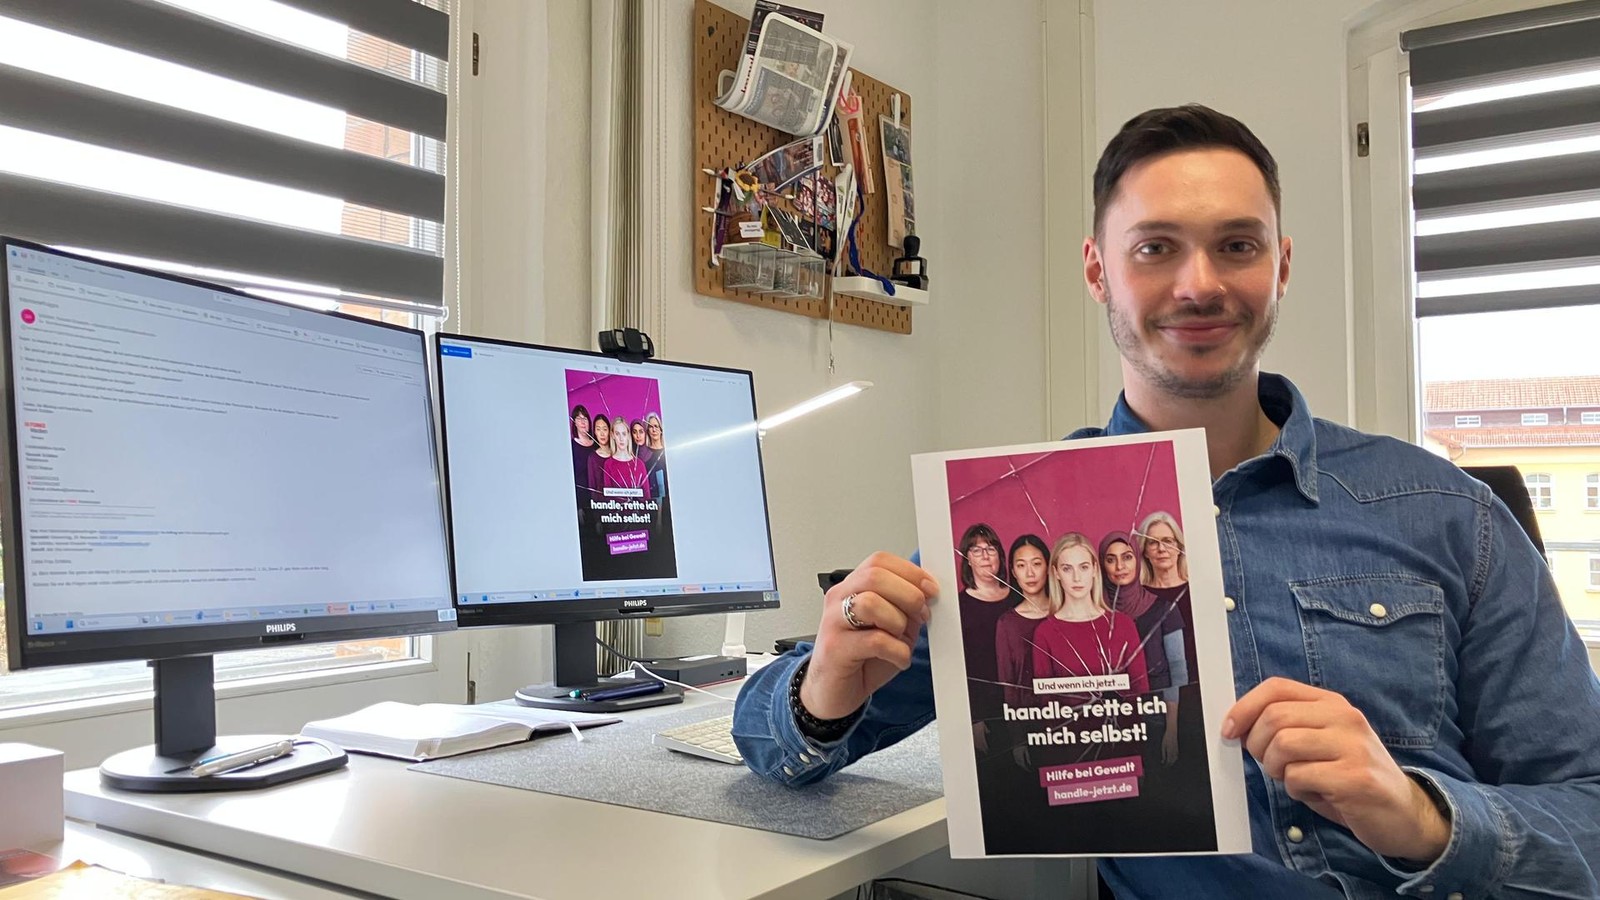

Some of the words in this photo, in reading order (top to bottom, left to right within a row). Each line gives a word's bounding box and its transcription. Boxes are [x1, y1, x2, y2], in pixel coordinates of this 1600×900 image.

[590, 499, 623, 511] handle,
[624, 500, 645, 510] rette
[645, 499, 658, 511] ich
[601, 513, 622, 523] mich
[623, 513, 651, 524] selbst!
[624, 599, 647, 607] PHILIPS
[266, 623, 296, 633] PHILIPS
[1037, 681, 1056, 691] Und
[1057, 681, 1081, 690] wenn
[1081, 679, 1095, 689] ich
[1095, 678, 1117, 691] jetzt
[1003, 702, 1079, 721] handle,
[1082, 699, 1133, 718] rette
[1137, 696, 1168, 715] ich
[1027, 727, 1076, 745] mich
[1080, 723, 1148, 745] selbst!
[1046, 769, 1074, 782] Hilfe
[1075, 767, 1093, 779] bei
[1094, 762, 1136, 776] Gewalt
[1053, 783, 1133, 800] handle-jetzt.de
